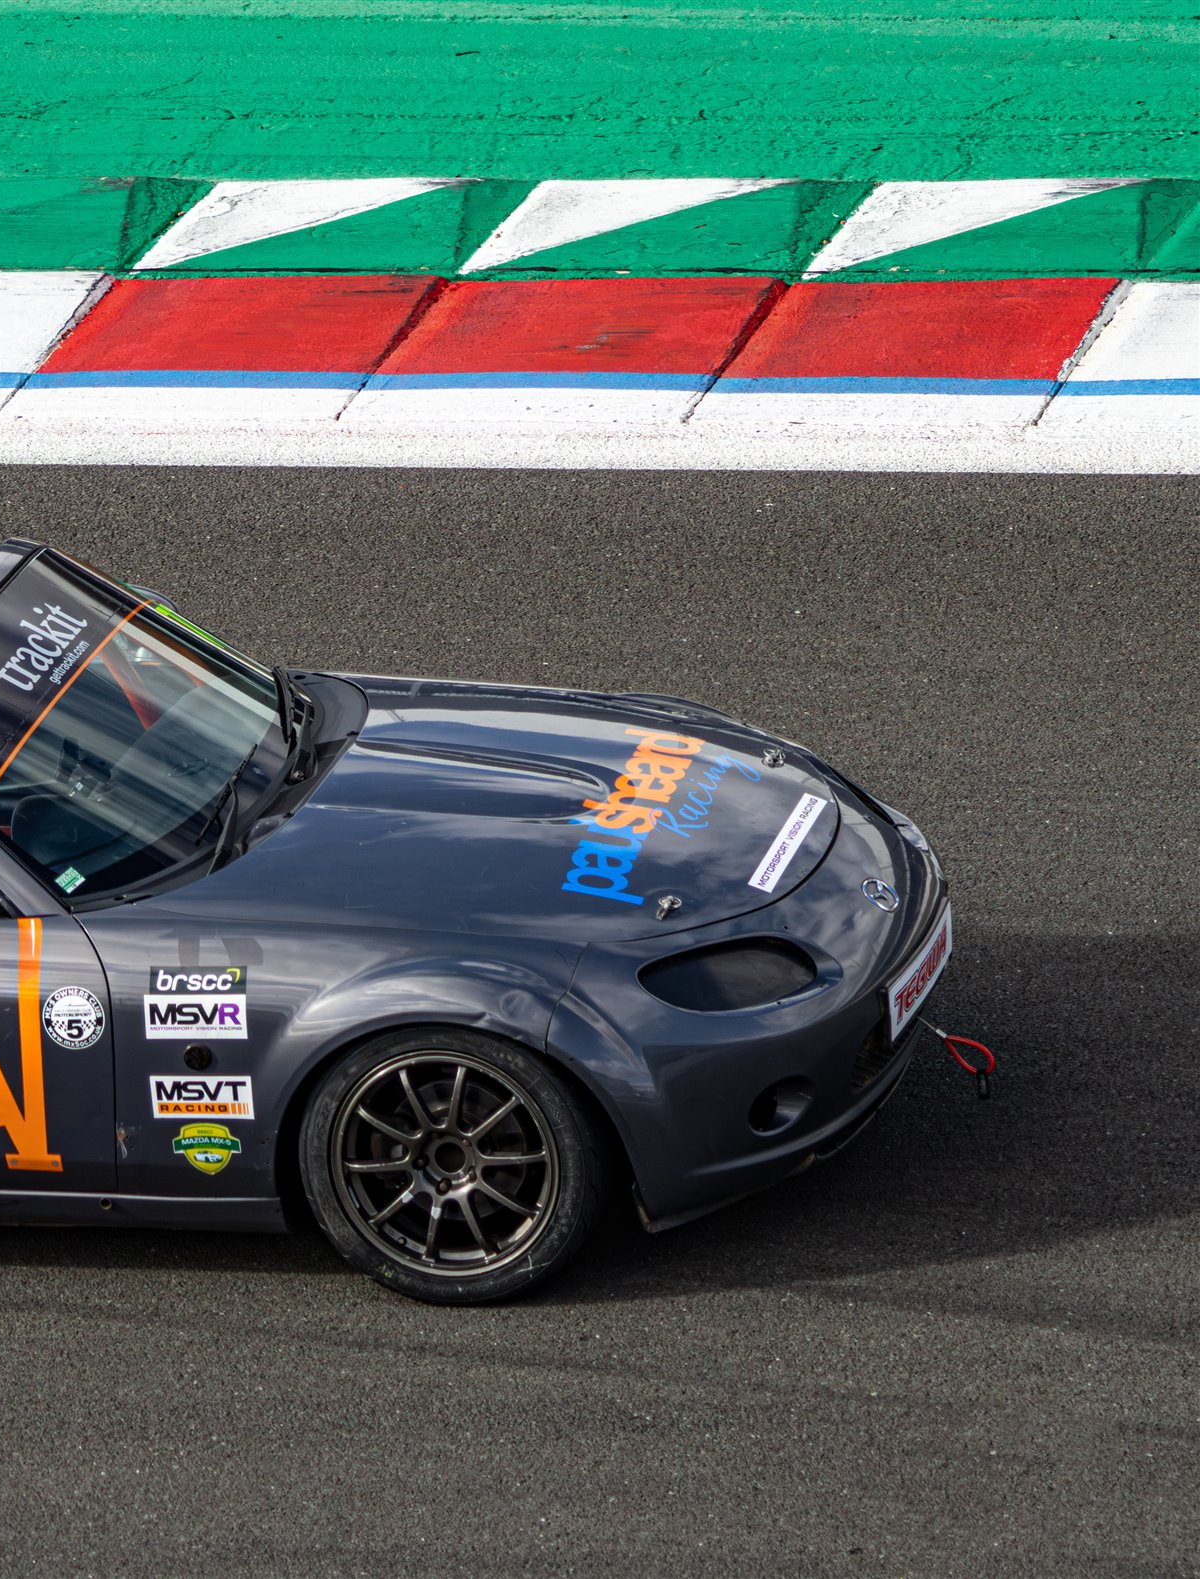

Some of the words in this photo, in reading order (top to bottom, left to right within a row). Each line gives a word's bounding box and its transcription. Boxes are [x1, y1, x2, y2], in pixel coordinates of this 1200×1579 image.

[49, 640, 90, 685] gettrackit.com
[650, 751, 763, 839] Racing
[757, 841, 790, 887] MOTORSPORT
[786, 819, 805, 841] VISION
[799, 797, 818, 820] RACING
[156, 969, 233, 991] brscc
[44, 999, 56, 1019] MX-5
[54, 988, 89, 1001] OWNERS
[88, 997, 103, 1018] CLUB
[149, 1003, 242, 1025] MSVR
[67, 1019, 84, 1039] 5
[155, 1080, 246, 1101] MSVT
[160, 1104, 228, 1112] RACING
[181, 1136, 209, 1146] MAZDA
[211, 1137, 231, 1146] MX-5
